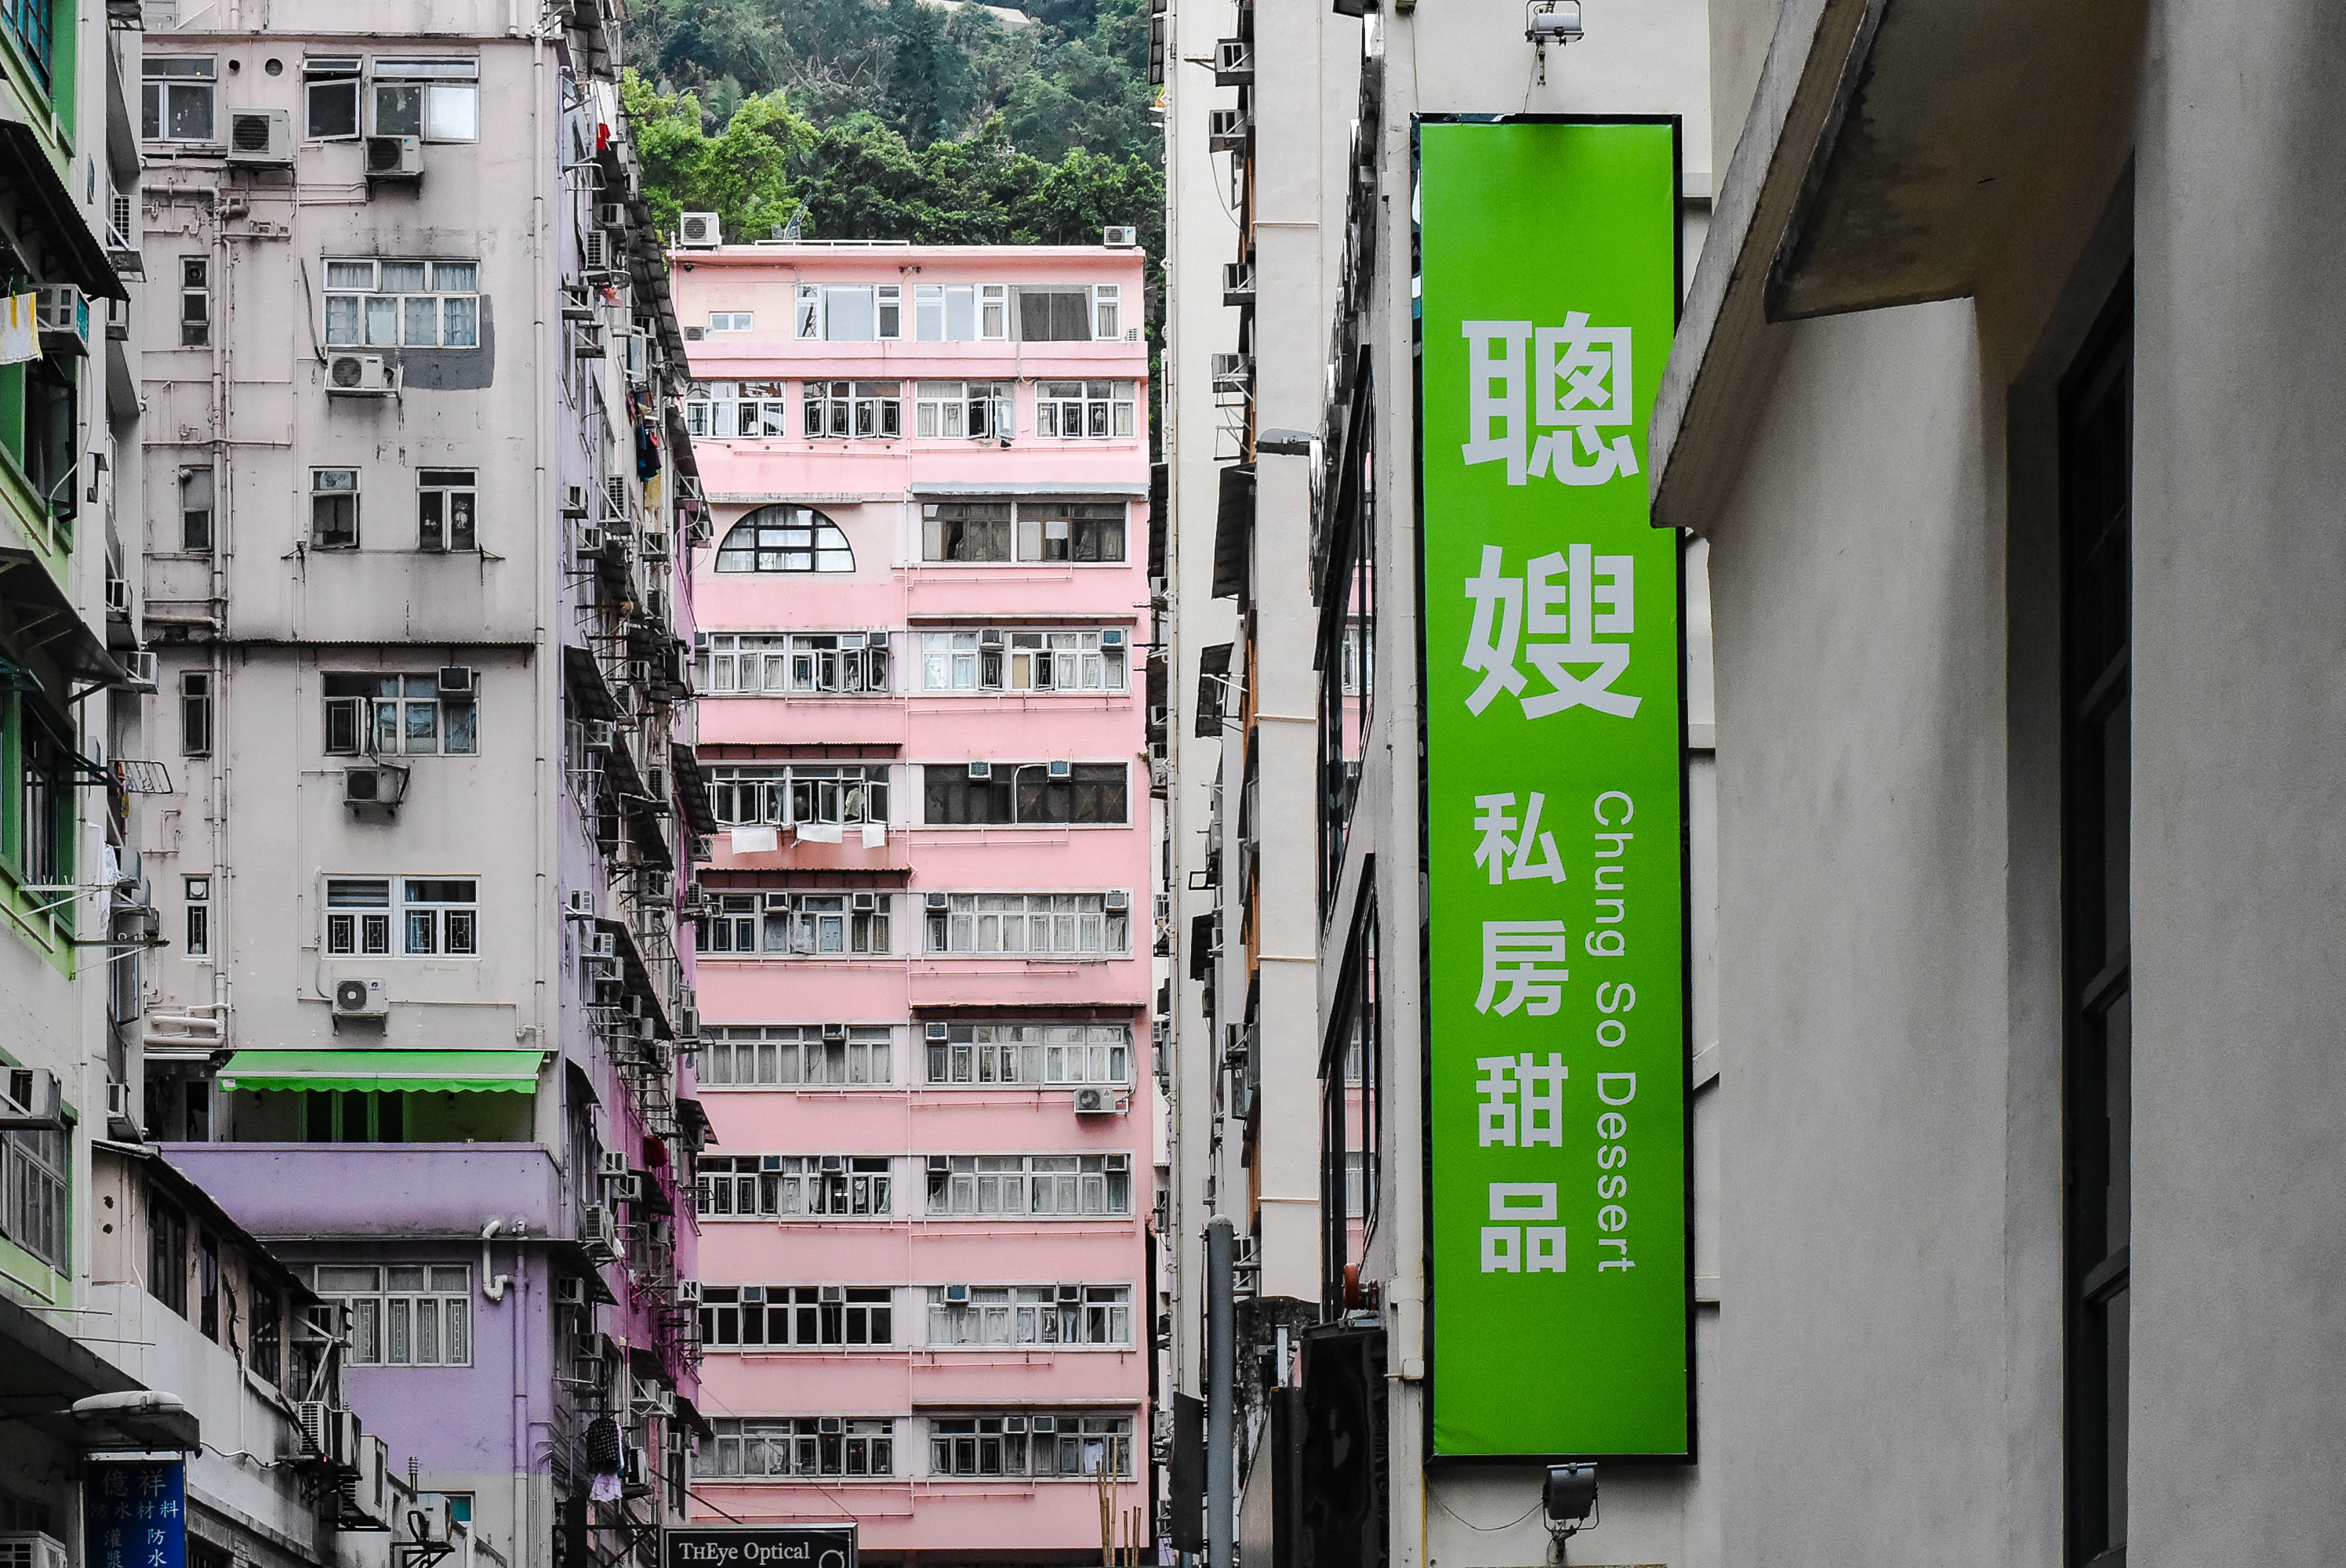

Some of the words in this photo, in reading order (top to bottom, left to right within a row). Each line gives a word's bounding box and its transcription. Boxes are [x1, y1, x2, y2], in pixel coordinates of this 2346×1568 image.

[1461, 310, 1643, 720] 聰嫂
[1585, 790, 1634, 956] Chung
[1473, 791, 1569, 1273] 私房甜品
[1595, 981, 1636, 1047] So
[1596, 1072, 1636, 1273] Dessert
[90, 1500, 180, 1519] 防水材料
[102, 1468, 166, 1497] 億祥
[147, 1529, 167, 1567] 防水
[743, 1541, 810, 1566] Optical
